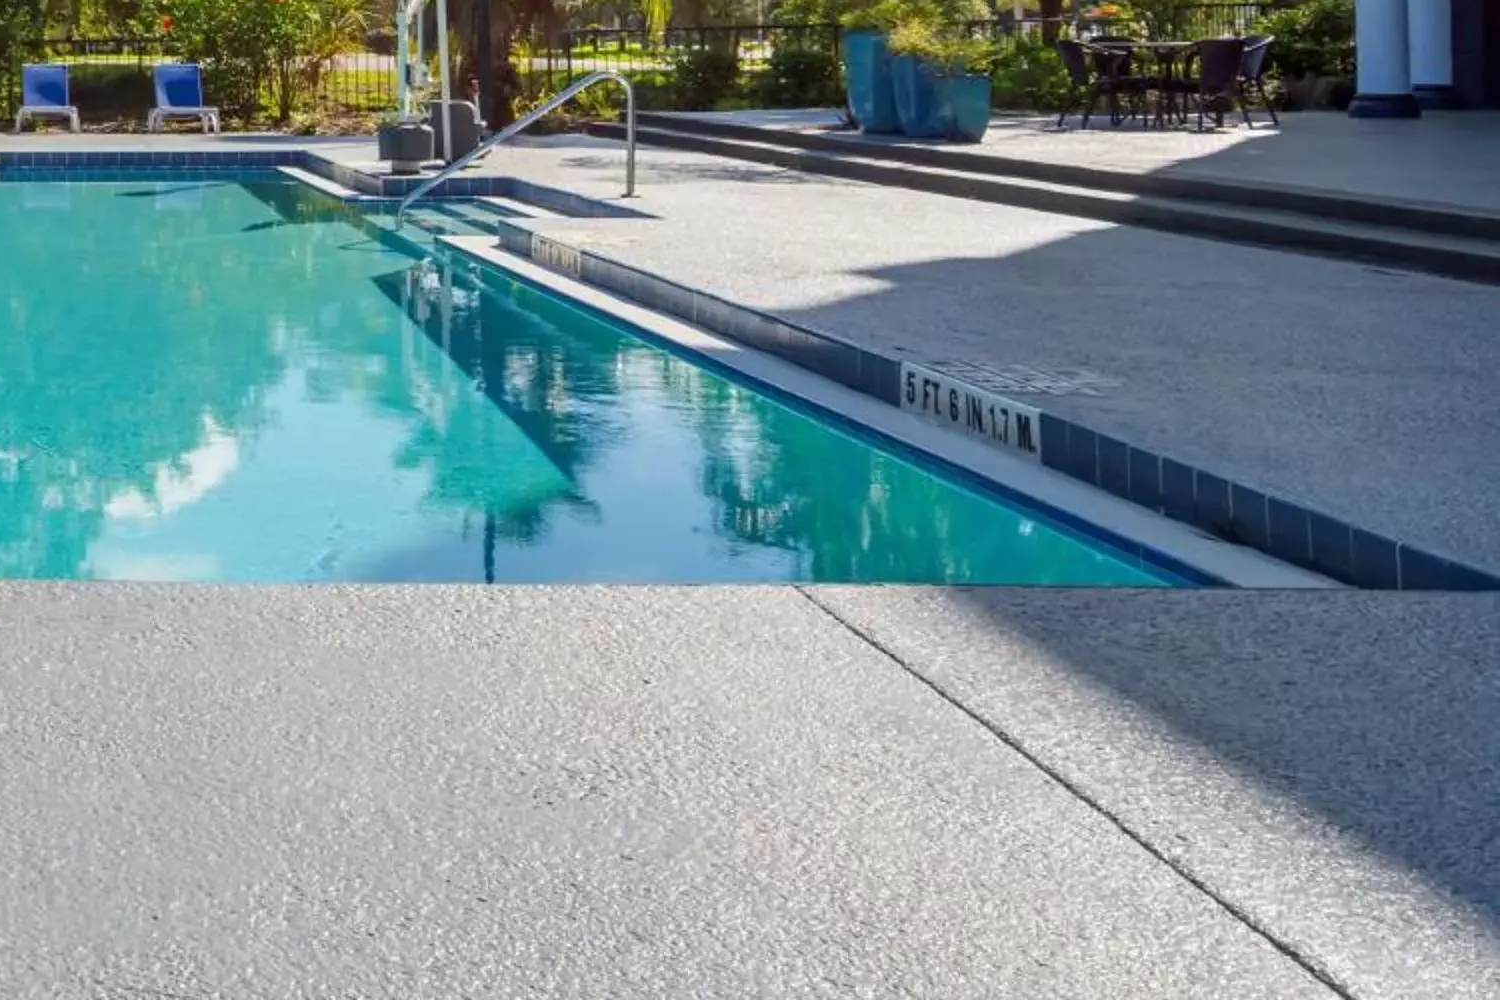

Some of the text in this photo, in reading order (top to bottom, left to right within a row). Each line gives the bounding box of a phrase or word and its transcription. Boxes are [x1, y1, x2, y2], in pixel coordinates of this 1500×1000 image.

[905, 370, 916, 405] 5
[949, 387, 960, 423] 6
[989, 403, 1009, 446] 1.7
